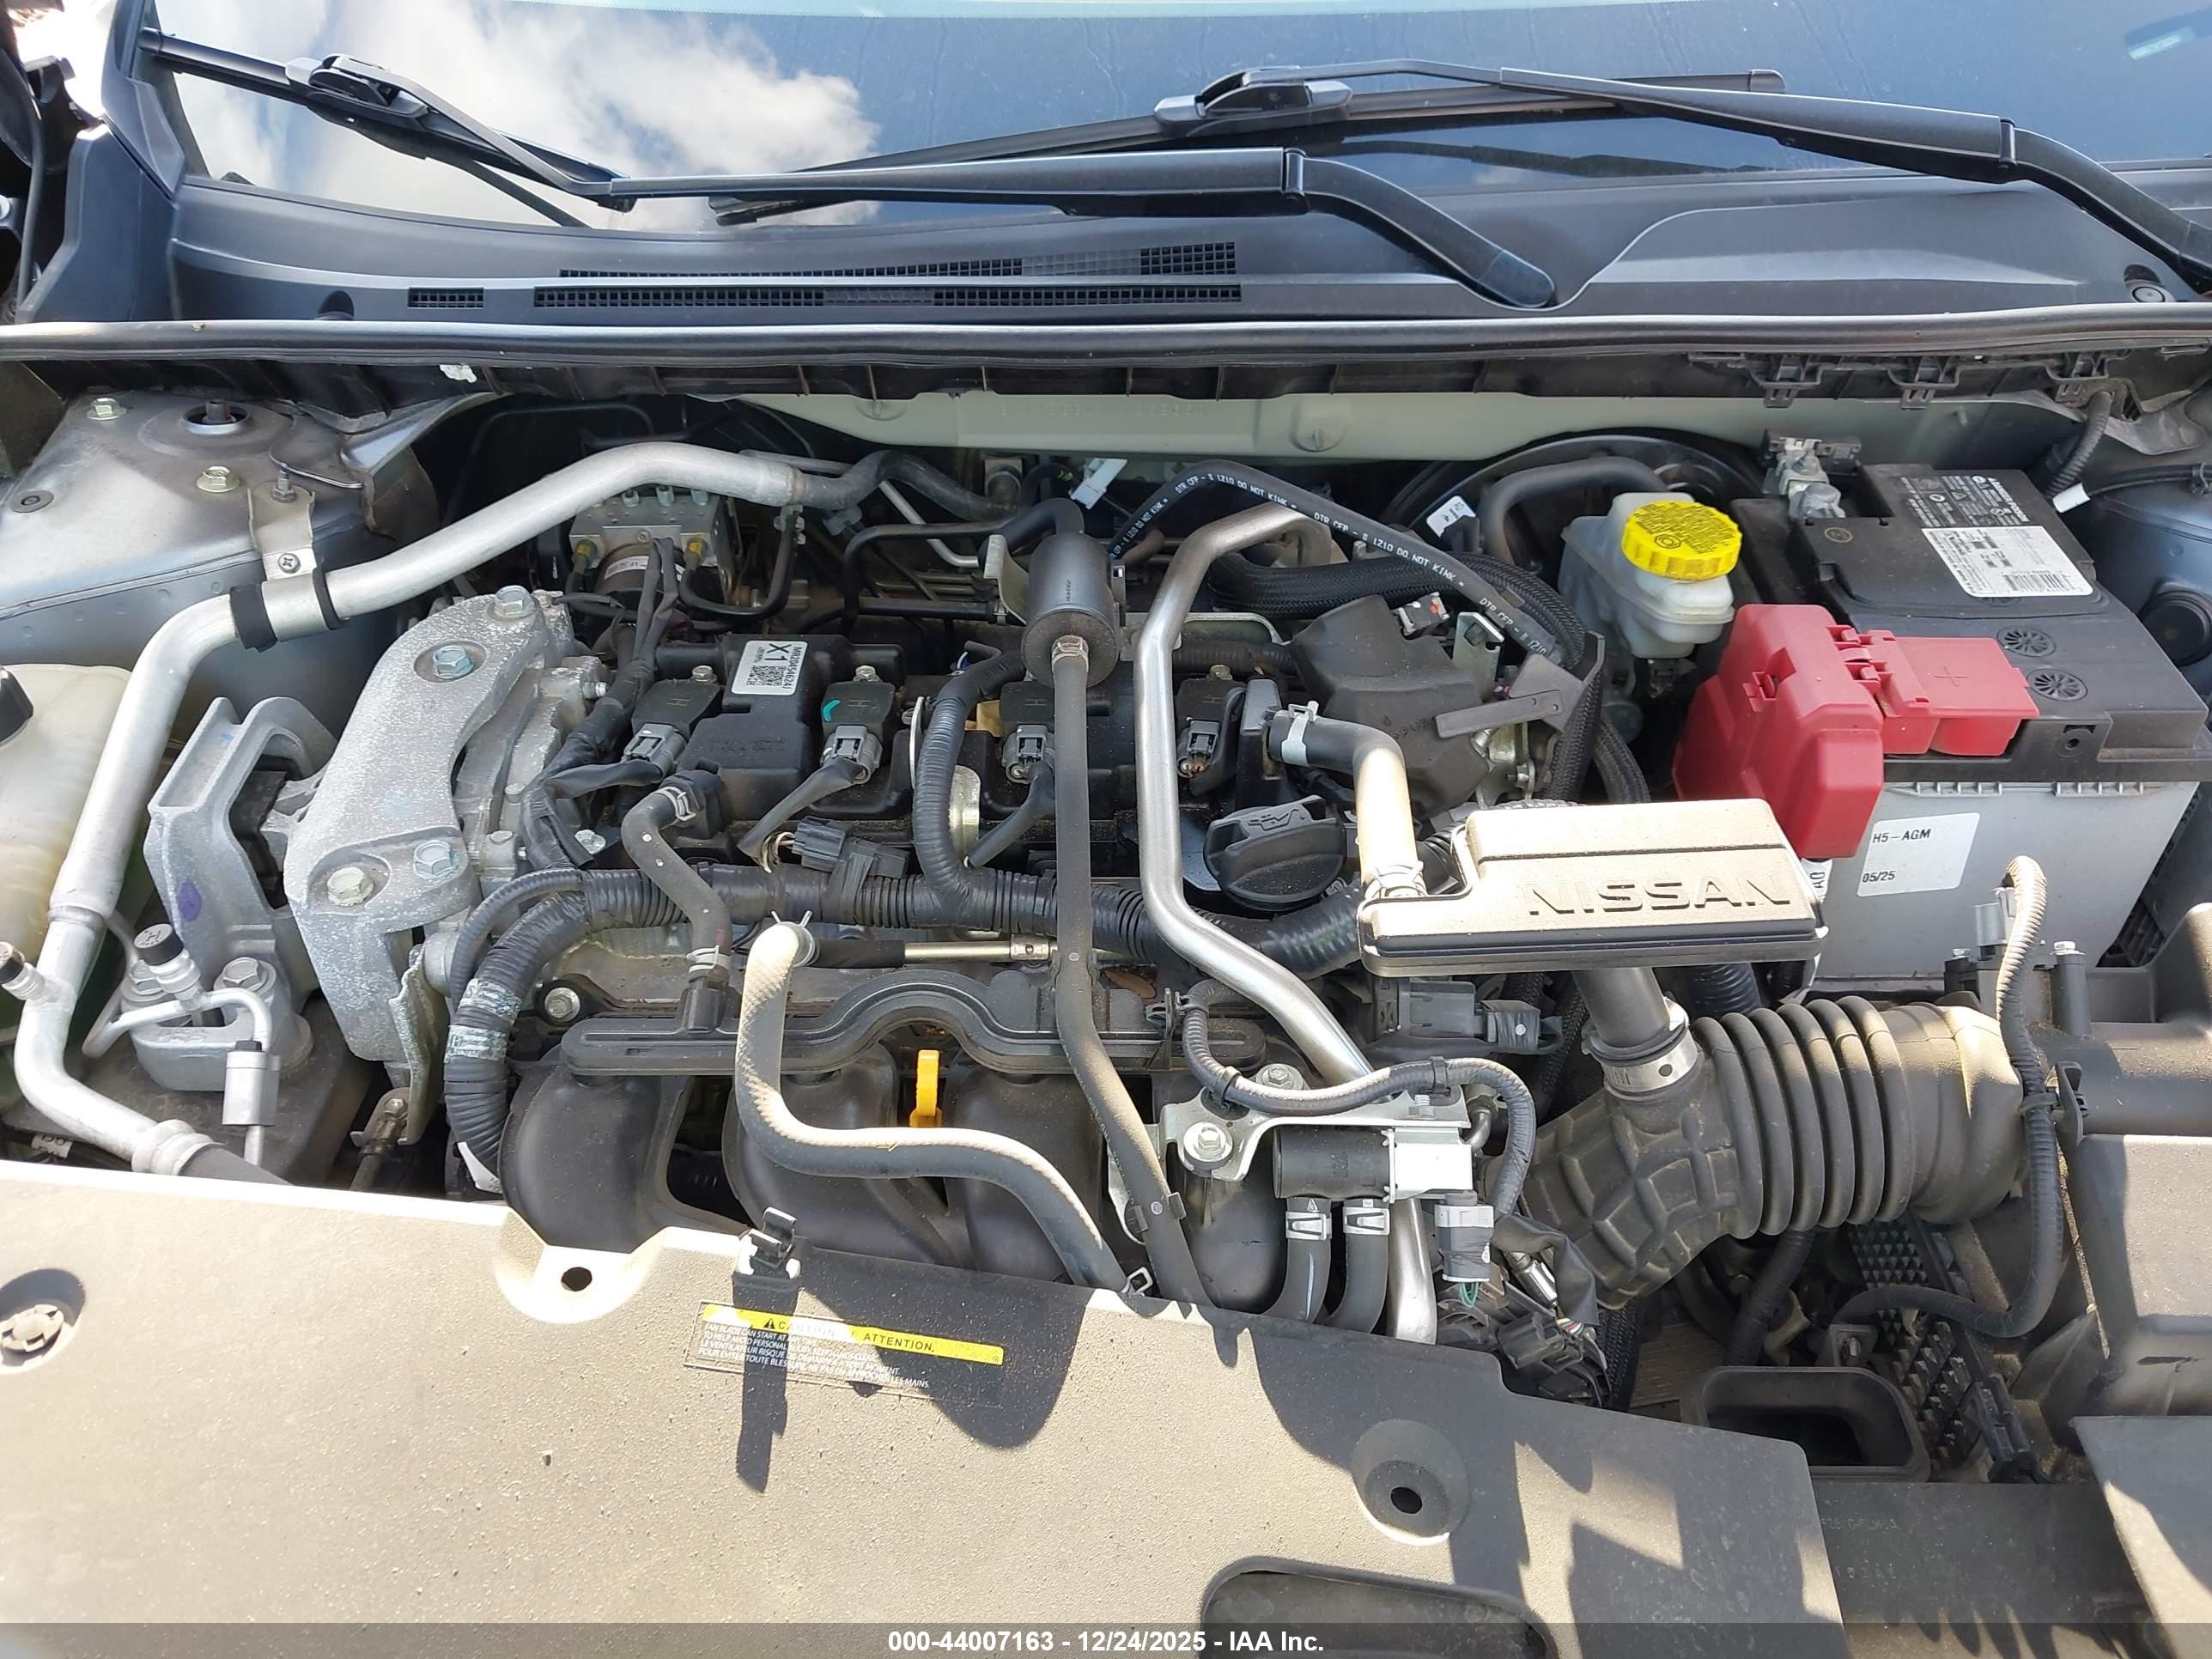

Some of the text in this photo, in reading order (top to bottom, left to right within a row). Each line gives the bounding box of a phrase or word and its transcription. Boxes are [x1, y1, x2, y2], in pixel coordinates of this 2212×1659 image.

[1249, 485, 1266, 496] NOT
[1267, 492, 1288, 507] KINK
[1314, 512, 1330, 524] DTR
[1333, 520, 1349, 532] CFP
[1373, 536, 1394, 552] 1210
[1396, 546, 1409, 558] DO
[1412, 554, 1430, 567] NOT
[1431, 562, 1457, 581] KINK
[763, 643, 792, 660] X1
[1862, 870, 1896, 884] 05/25
[1523, 878, 1790, 916] NISSAN
[741, 1328, 757, 1337] CAN
[757, 1331, 776, 1340] START
[753, 1339, 787, 1350] PERSONAL
[746, 1355, 769, 1364] TOUTE
[904, 1377, 931, 1389] MAINS.
[758, 1347, 785, 1358] RISQUE
[866, 1364, 900, 1376] MOMENT.
